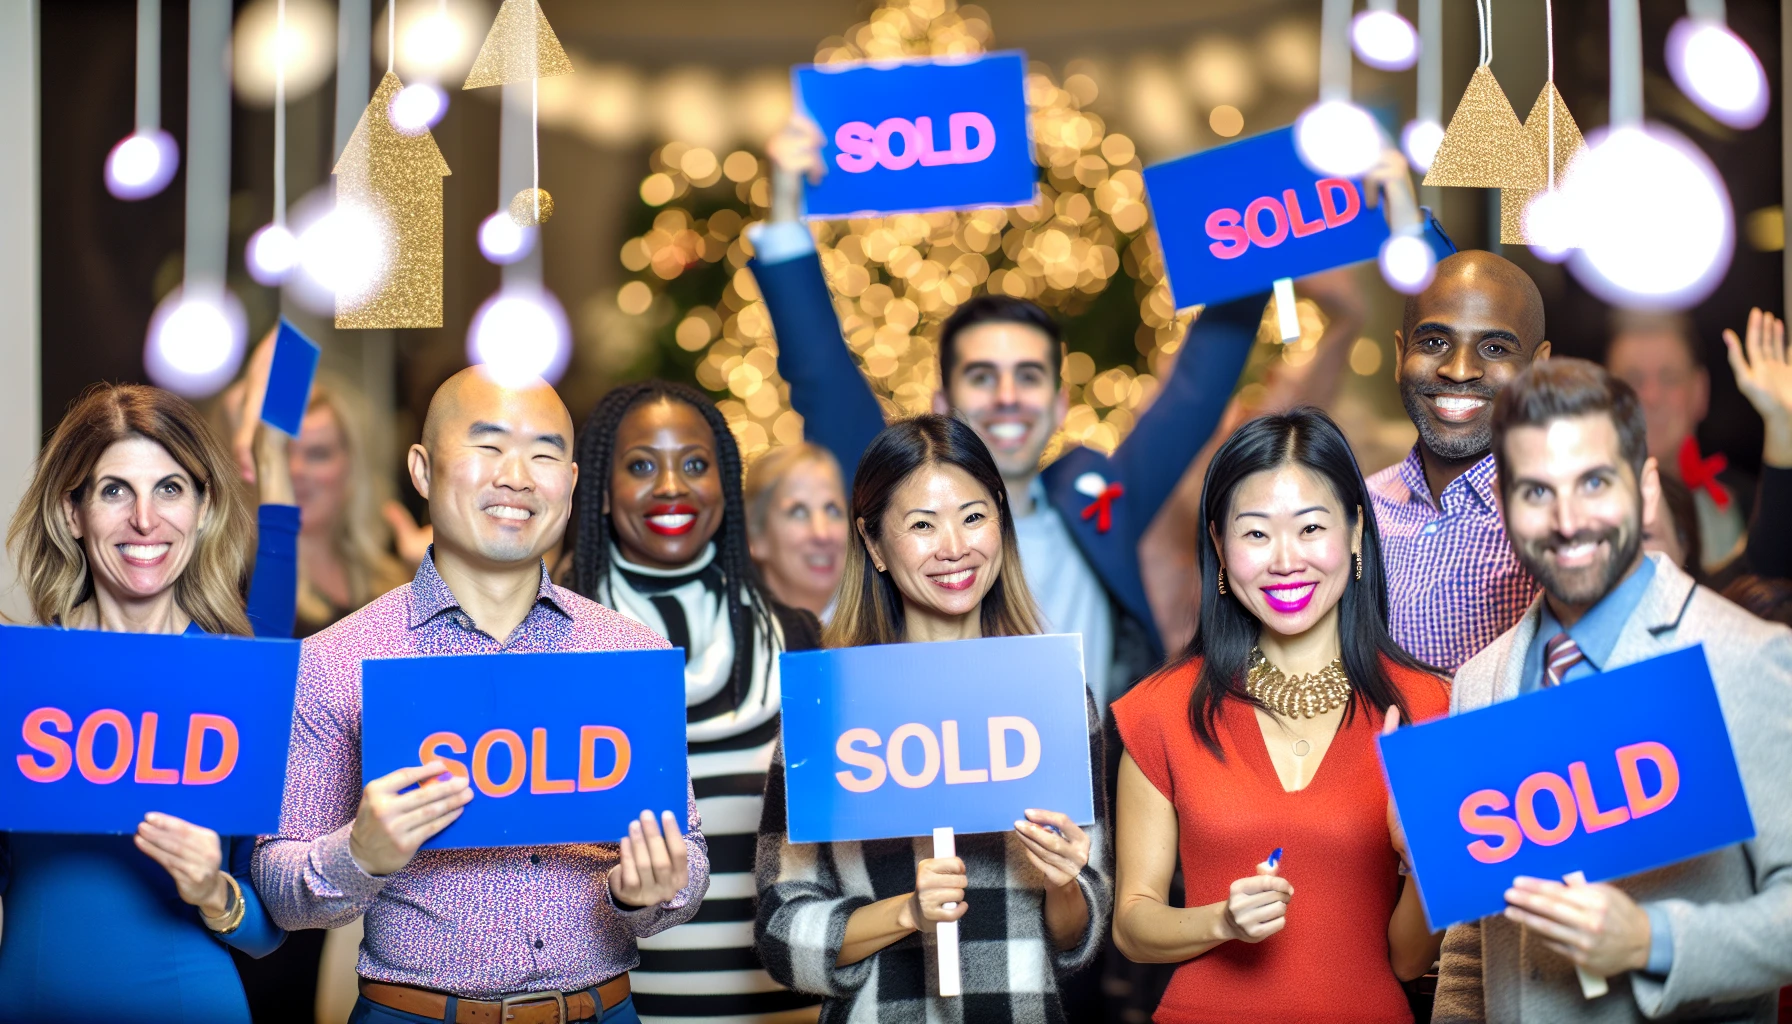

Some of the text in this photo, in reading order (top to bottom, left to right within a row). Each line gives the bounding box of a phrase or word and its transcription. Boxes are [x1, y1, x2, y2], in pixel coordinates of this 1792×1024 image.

[835, 111, 996, 173] SOLD
[1205, 178, 1361, 260] SOLD
[17, 707, 239, 785] SOLD
[419, 725, 631, 797] SOLD
[836, 717, 1041, 792] SOLD
[1458, 742, 1680, 864] SOLD
